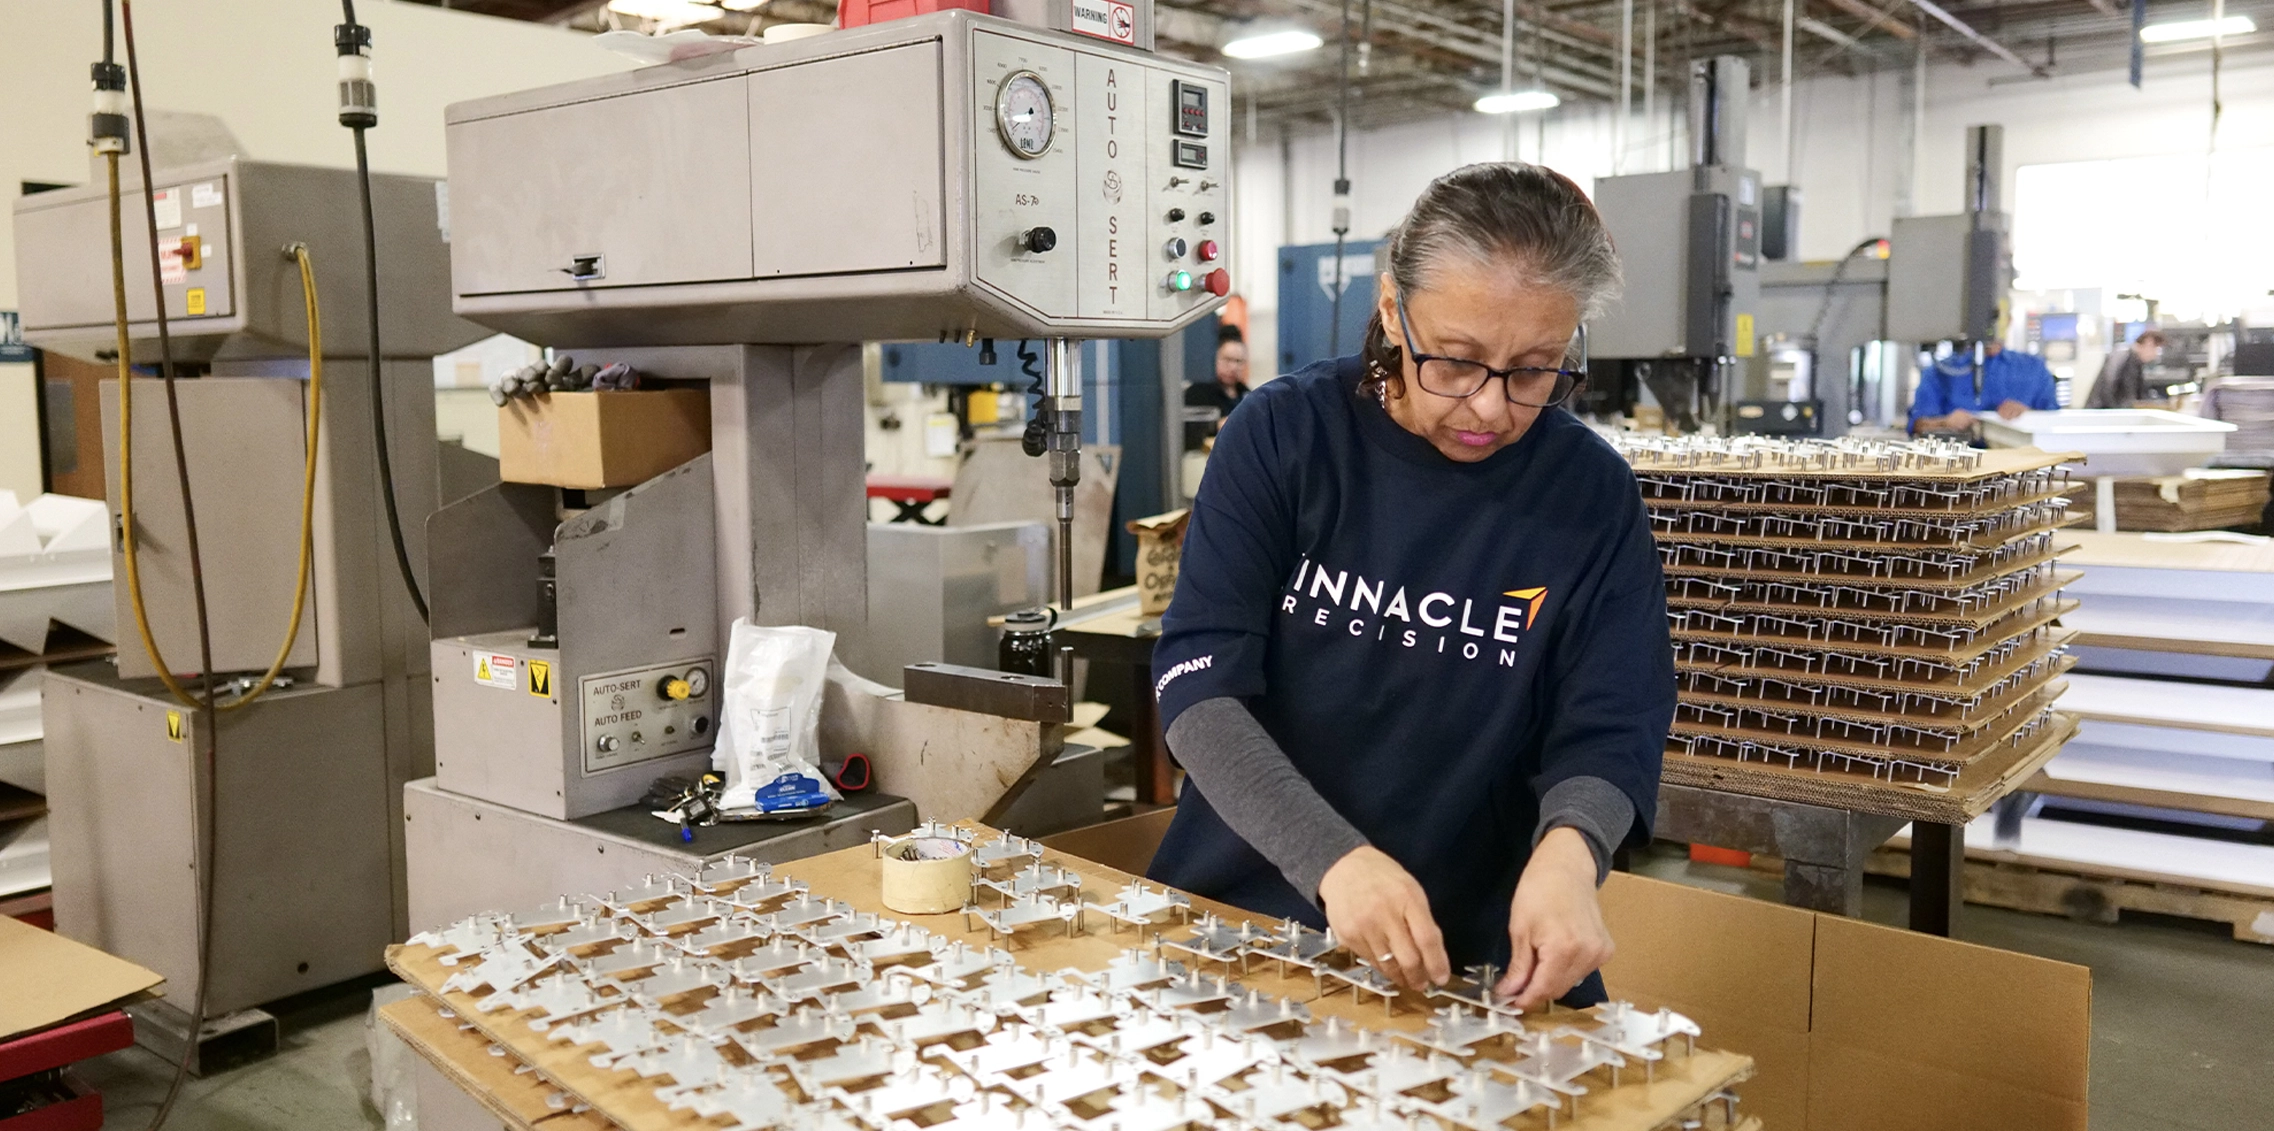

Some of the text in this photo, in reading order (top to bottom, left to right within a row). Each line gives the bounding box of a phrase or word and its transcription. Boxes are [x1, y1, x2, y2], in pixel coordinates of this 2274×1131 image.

[1074, 6, 1107, 24] WARNING
[1107, 68, 1117, 159] AUTO
[1108, 216, 1118, 305] SERT
[1293, 558, 1523, 644] INNACLE
[1281, 593, 1516, 668] RECISION
[593, 680, 641, 696] AUTO-SERT
[1158, 655, 1213, 691] COMPANY
[595, 710, 642, 727] AUTO FEED
